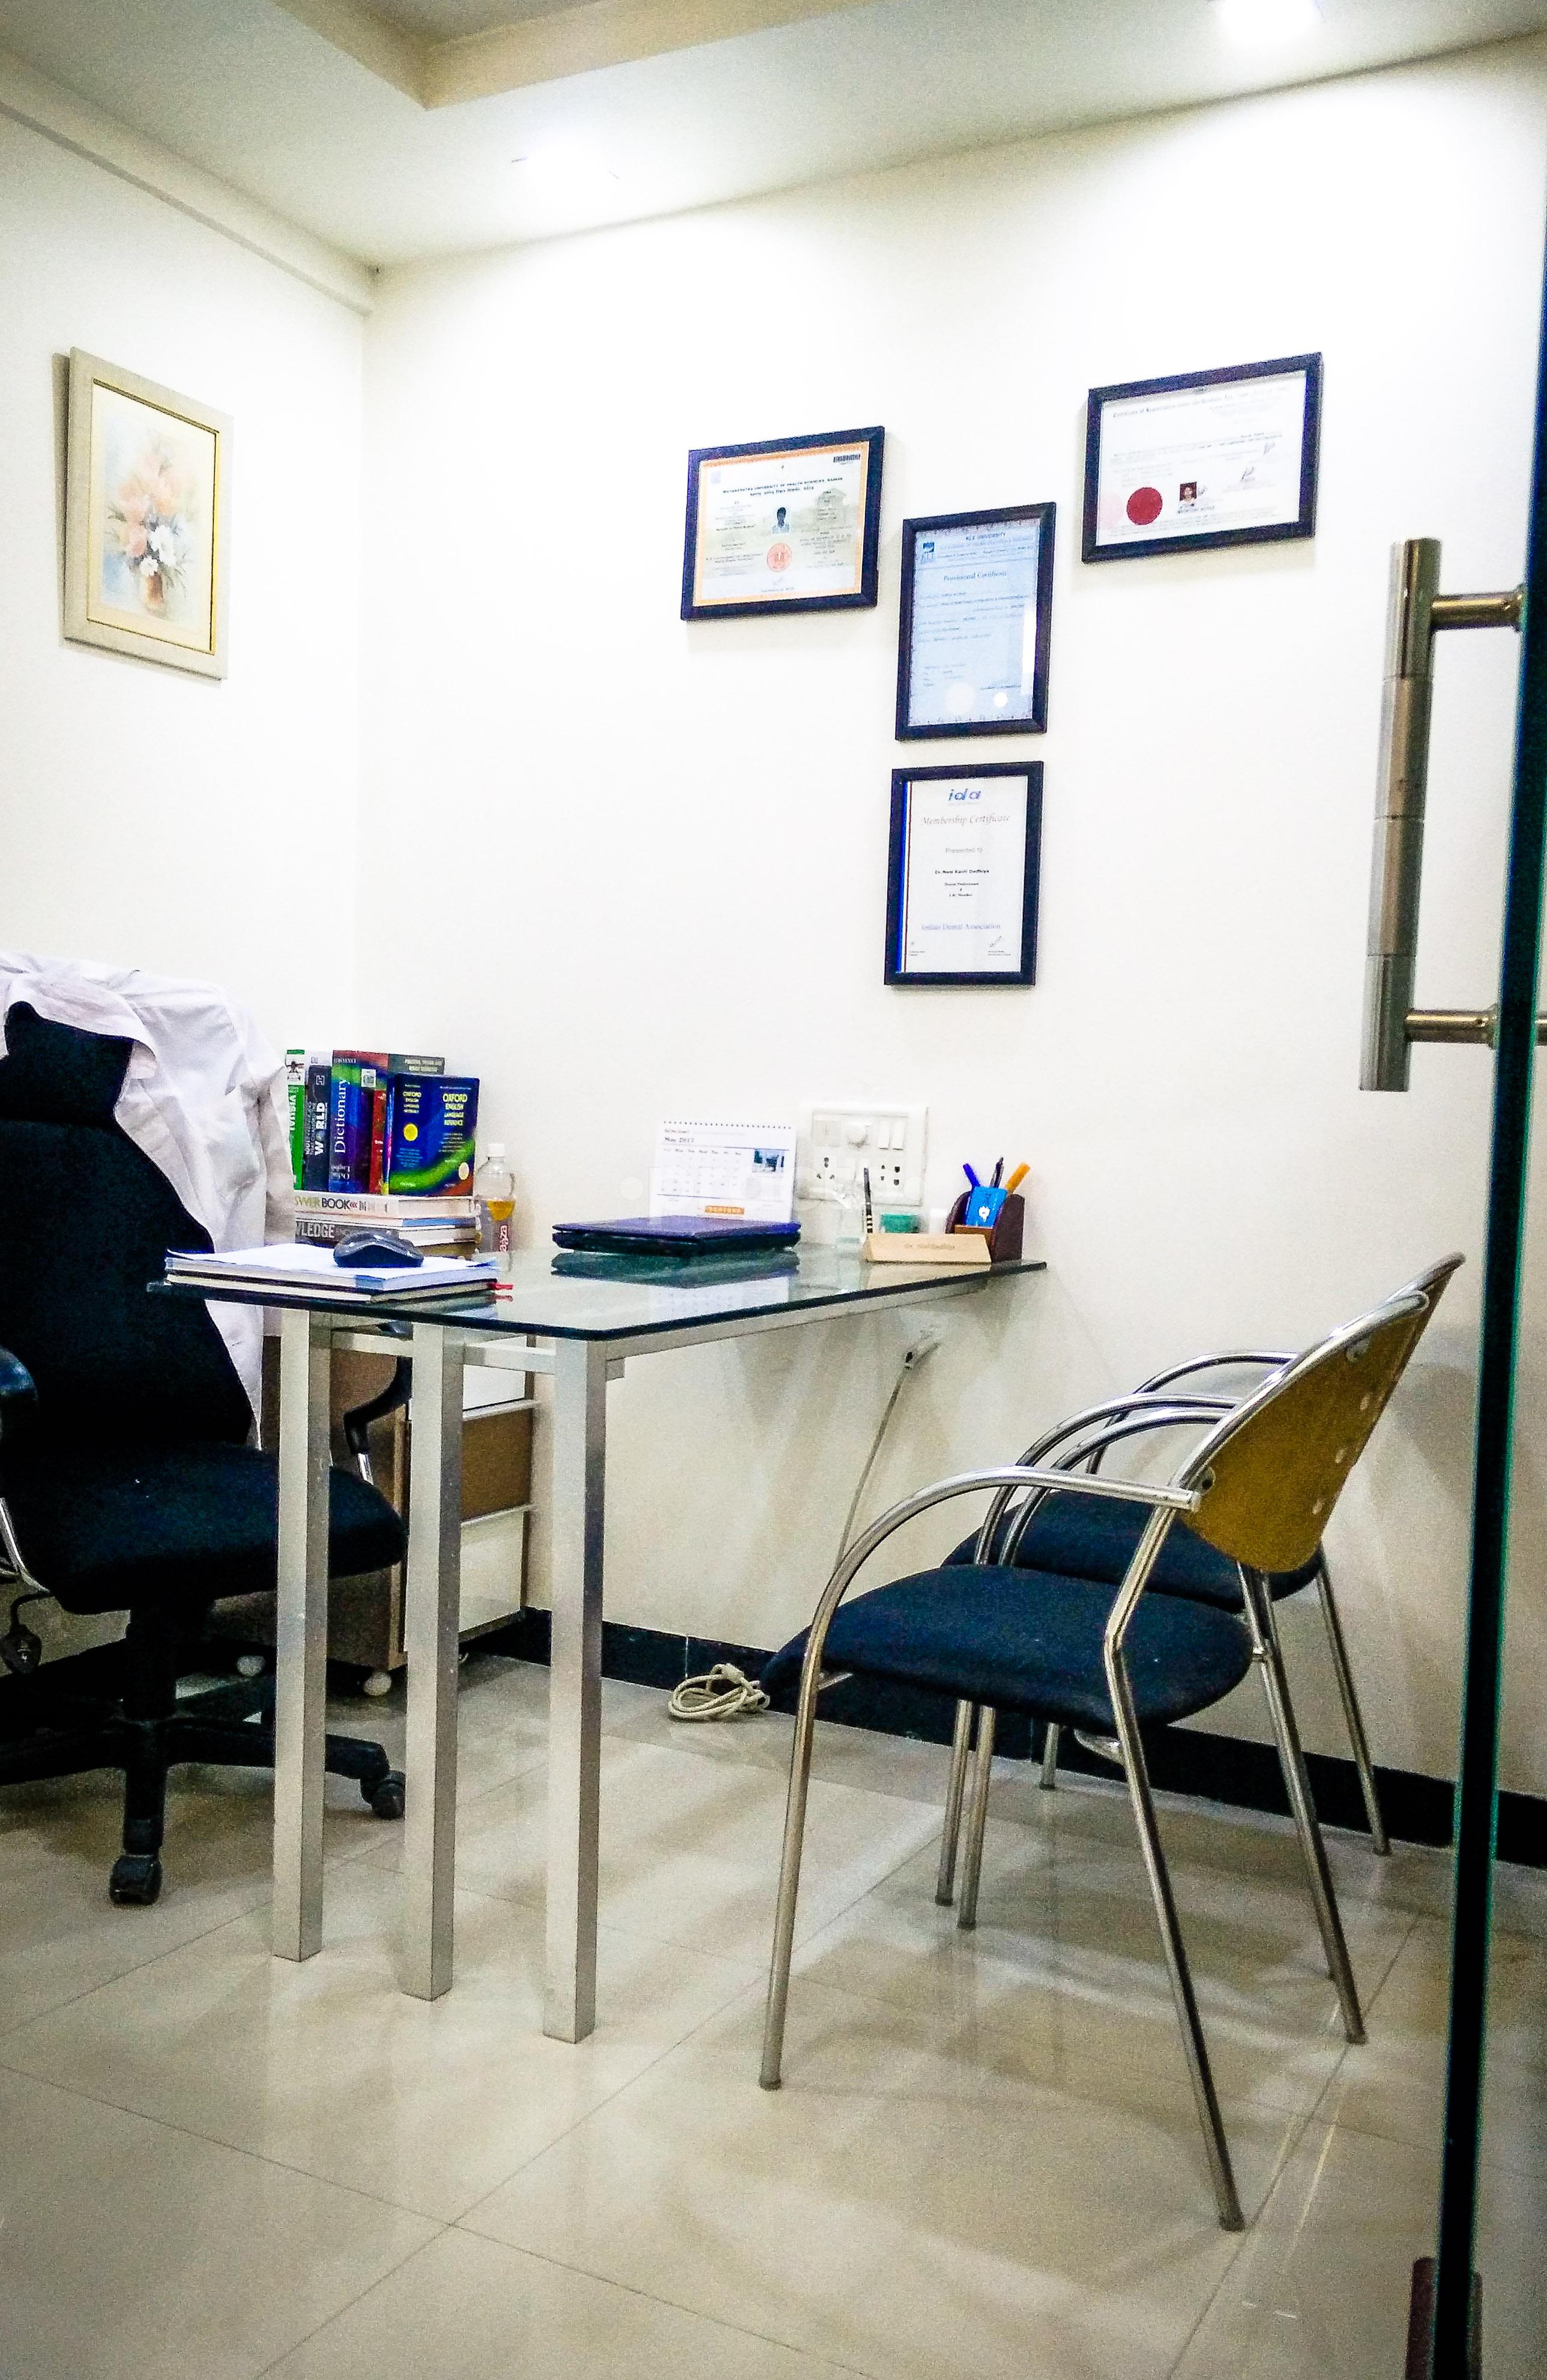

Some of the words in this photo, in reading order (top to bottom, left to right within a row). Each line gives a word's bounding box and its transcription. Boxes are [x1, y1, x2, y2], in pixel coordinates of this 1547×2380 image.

[921, 815, 967, 827] Membership
[970, 812, 1011, 826] Certificate
[442, 1093, 468, 1102] OXFORD
[314, 1102, 326, 1156] WORLD
[334, 1078, 351, 1154] Dictionary
